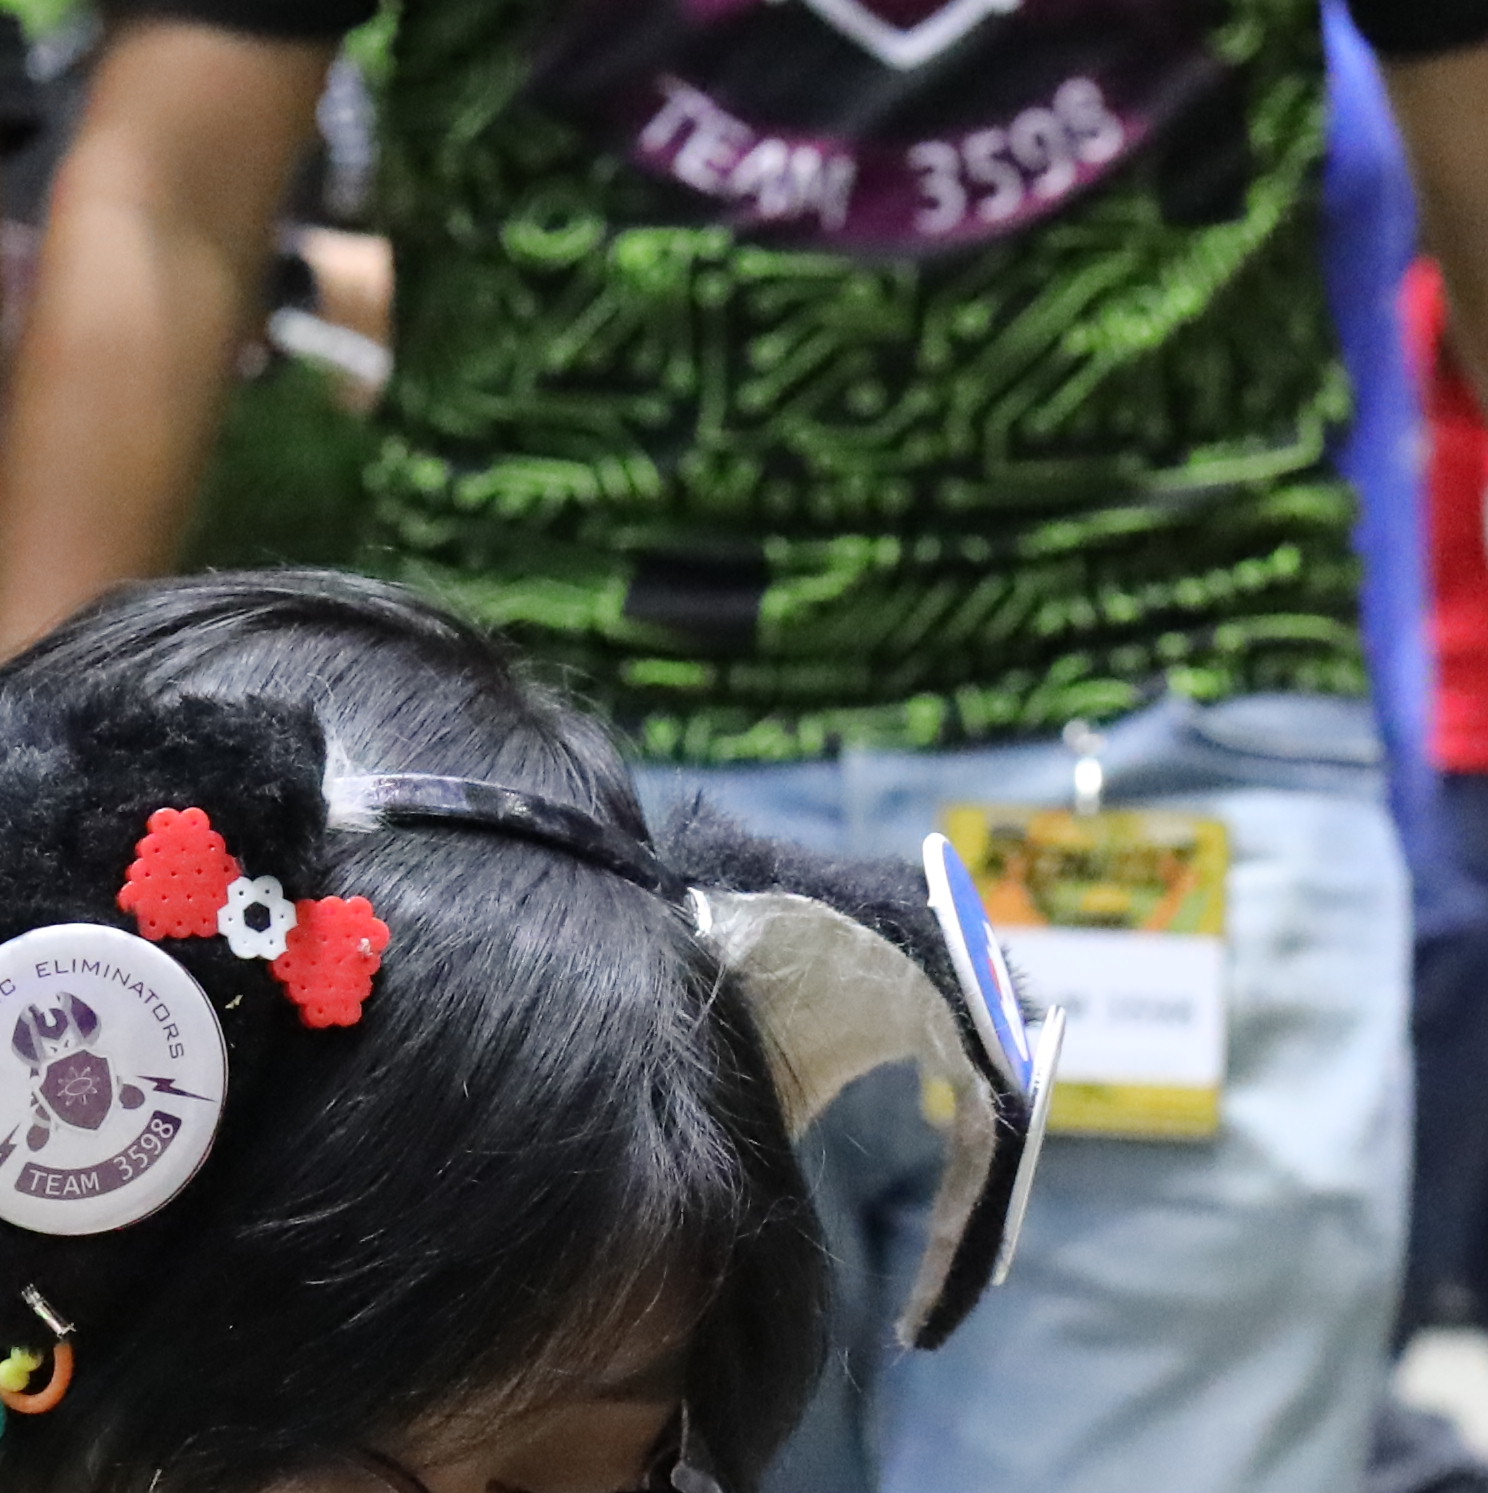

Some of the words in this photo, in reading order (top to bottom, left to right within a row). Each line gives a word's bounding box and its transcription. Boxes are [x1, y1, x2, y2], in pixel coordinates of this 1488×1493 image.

[638, 74, 860, 233] TEAM
[909, 76, 1126, 235] 3598
[35, 958, 185, 1059] ELIMINATORS
[28, 1168, 100, 1196] TEAM
[112, 1117, 175, 1182] 3598
